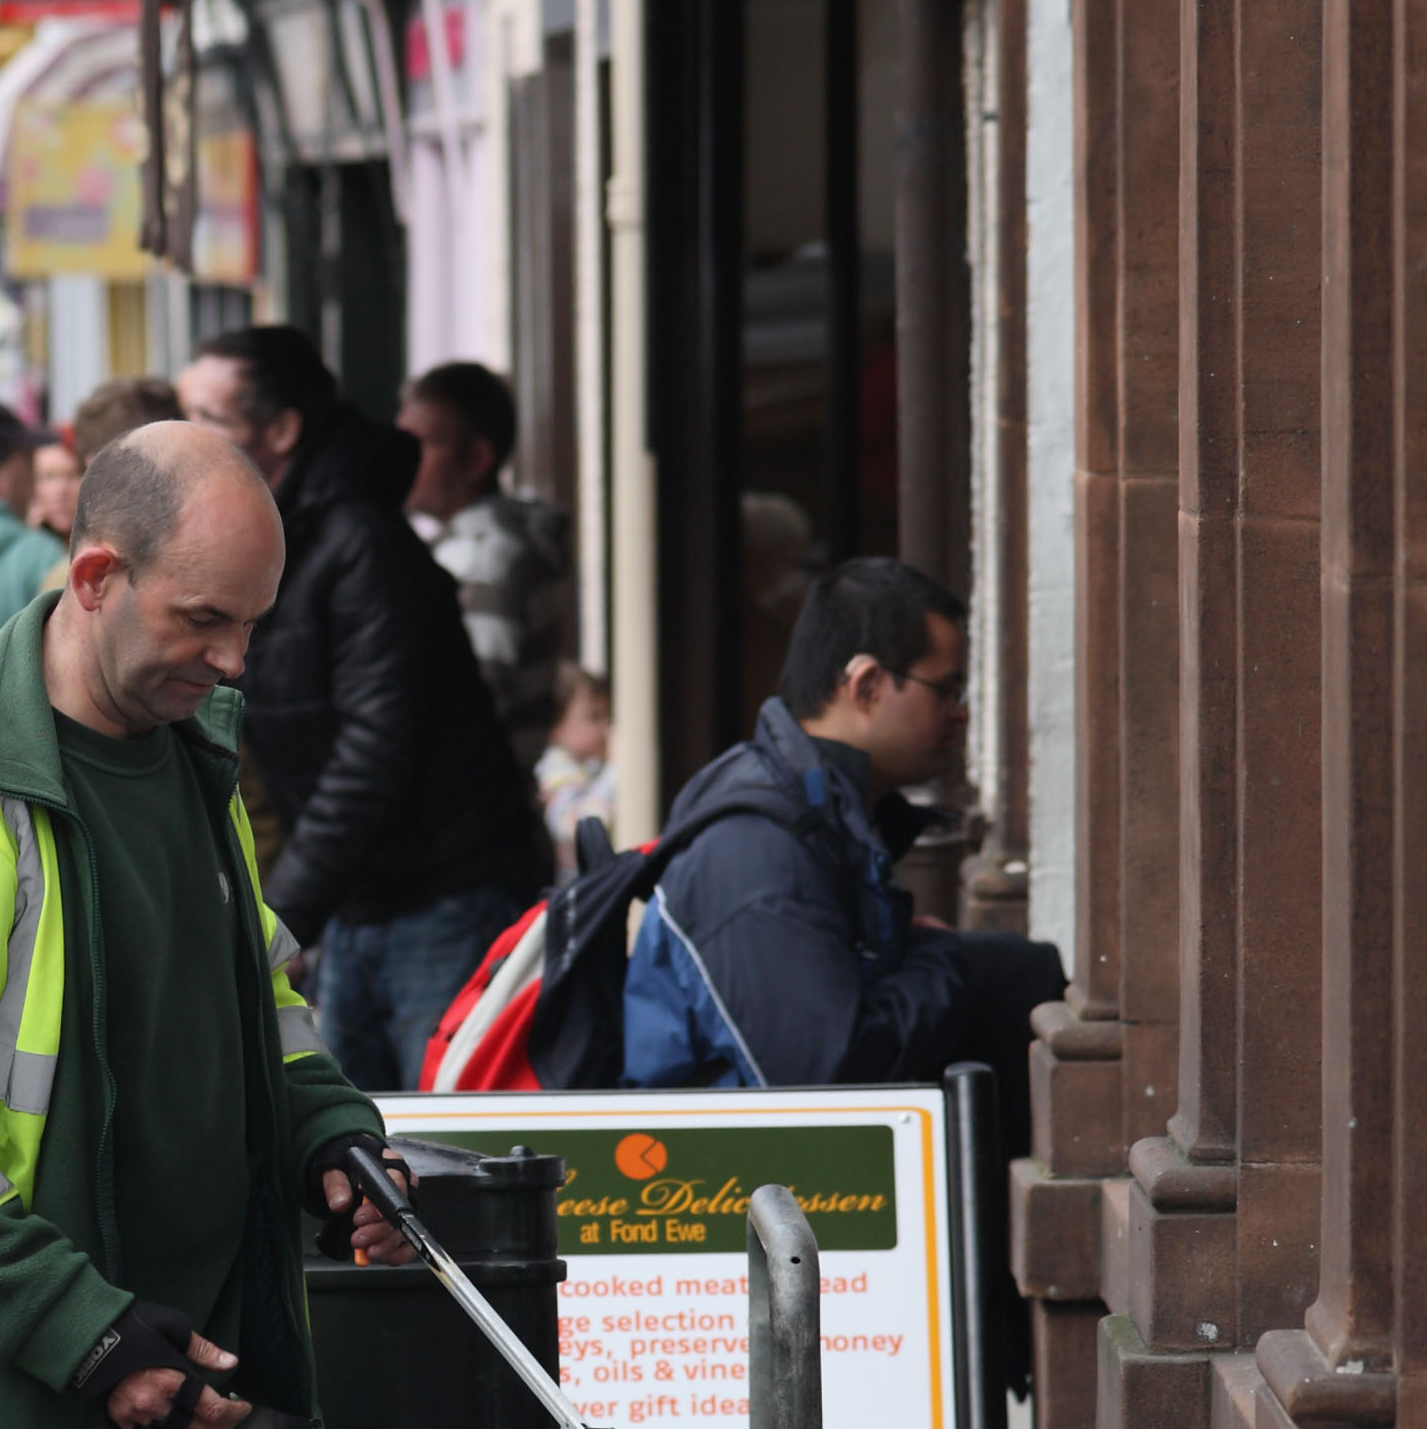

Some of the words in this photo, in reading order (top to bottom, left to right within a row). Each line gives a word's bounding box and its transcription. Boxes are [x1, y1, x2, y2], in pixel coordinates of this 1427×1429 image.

[635, 1176, 888, 1217] Delicessen
[579, 1222, 600, 1244] at
[609, 1220, 659, 1244] Fond
[665, 1218, 707, 1243] Ewe
[560, 1275, 663, 1298] cooked
[675, 1274, 749, 1297] meat
[602, 1310, 735, 1334] selection
[630, 1335, 749, 1358] preserve
[593, 1360, 644, 1382] oils
[653, 1359, 676, 1381] &
[684, 1359, 747, 1381] vine
[628, 1395, 680, 1422] gift
[691, 1393, 750, 1416] idea
